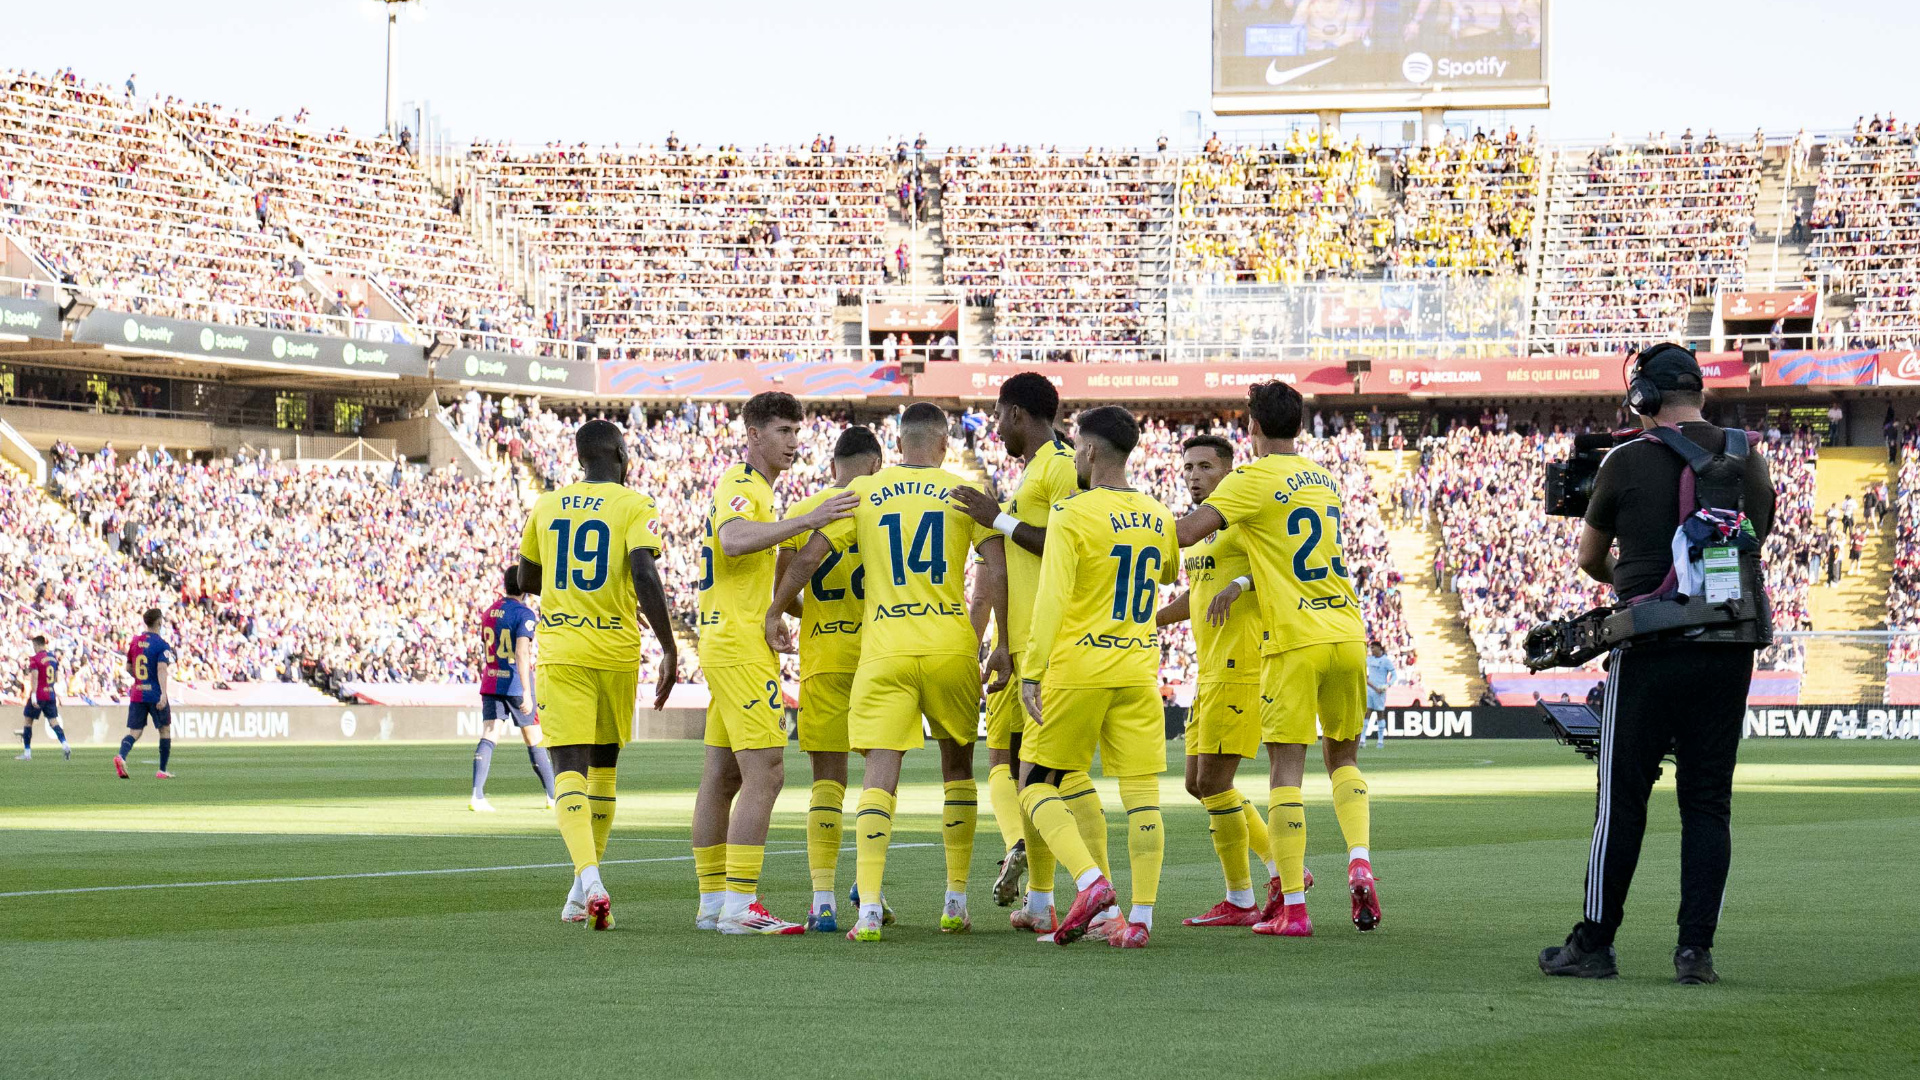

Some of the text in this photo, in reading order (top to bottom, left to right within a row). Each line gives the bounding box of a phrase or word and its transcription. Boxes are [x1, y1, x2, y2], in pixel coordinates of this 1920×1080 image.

[1437, 56, 1507, 78] Spotify
[4, 310, 41, 329] Spotify
[139, 325, 174, 344] Spotify
[215, 333, 249, 352] Spotify
[286, 341, 319, 359] Spotify
[356, 348, 388, 366] Spotify
[988, 375, 1002, 387] FC
[1087, 373, 1179, 388] MÉS QUE UN CLUB
[1221, 374, 1235, 386] FC
[1405, 370, 1482, 385] FC BARCELONA
[1506, 368, 1600, 383] MÉS QUE UN CLUB
[870, 481, 922, 507] SANTI
[1274, 471, 1342, 504] S.CARDON
[561, 495, 605, 511] PEPE
[1109, 512, 1166, 537] ÁLEX B.
[548, 518, 611, 592] 19
[877, 510, 948, 586] 14
[1184, 555, 1216, 572] AMESA
[1109, 543, 1162, 625] 16
[873, 602, 964, 622] ASCALE
[1297, 594, 1360, 611] ASCA
[483, 626, 516, 665] 24
[46, 665, 55, 684] 9
[135, 654, 149, 681] 6
[169, 711, 289, 739] NEW ALBUM
[1365, 710, 1473, 737] ALBUM
[1748, 709, 1822, 737] NEW
